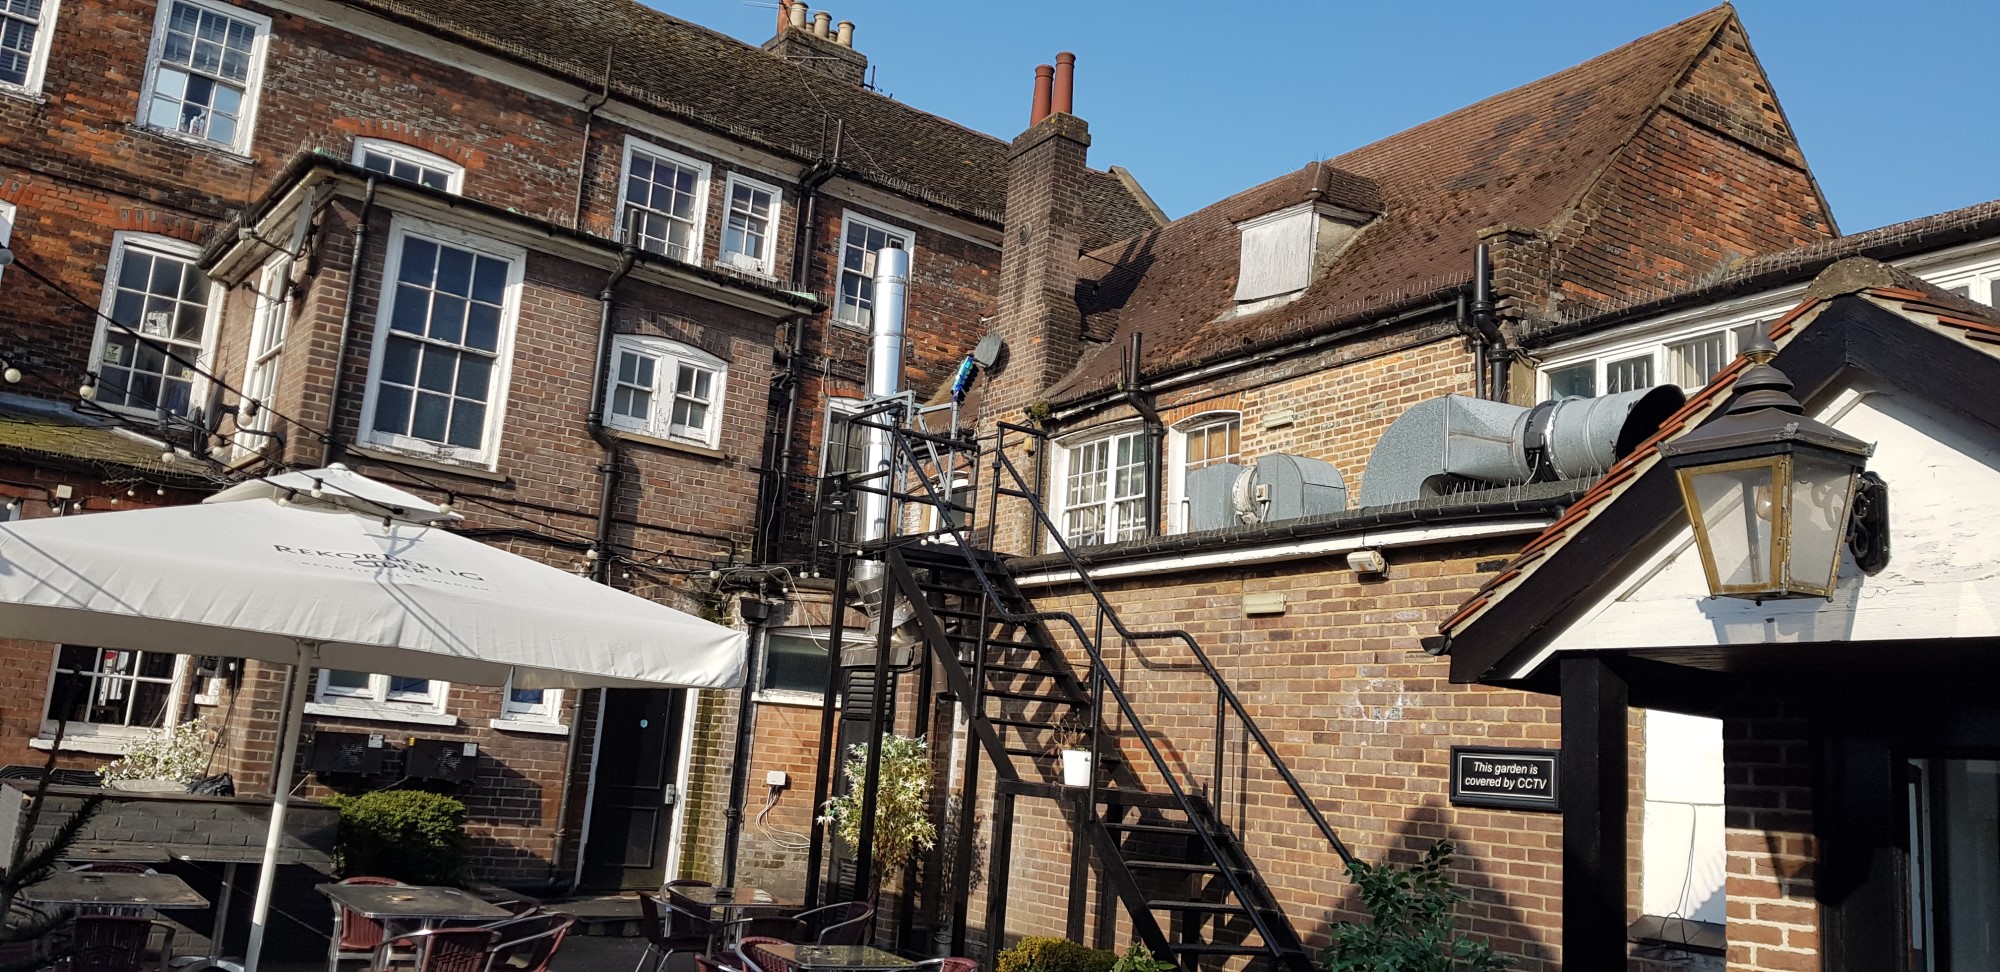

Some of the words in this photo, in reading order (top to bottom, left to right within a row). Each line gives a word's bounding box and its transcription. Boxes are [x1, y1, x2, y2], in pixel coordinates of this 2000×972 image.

[273, 544, 486, 581] REKORDERLIG
[353, 560, 426, 575] CIDER
[1474, 761, 1493, 773] This
[1494, 763, 1528, 775] garden
[1529, 764, 1538, 775] is
[1465, 777, 1501, 787] covered
[1503, 777, 1516, 790] by
[1517, 778, 1547, 790] CCTV
